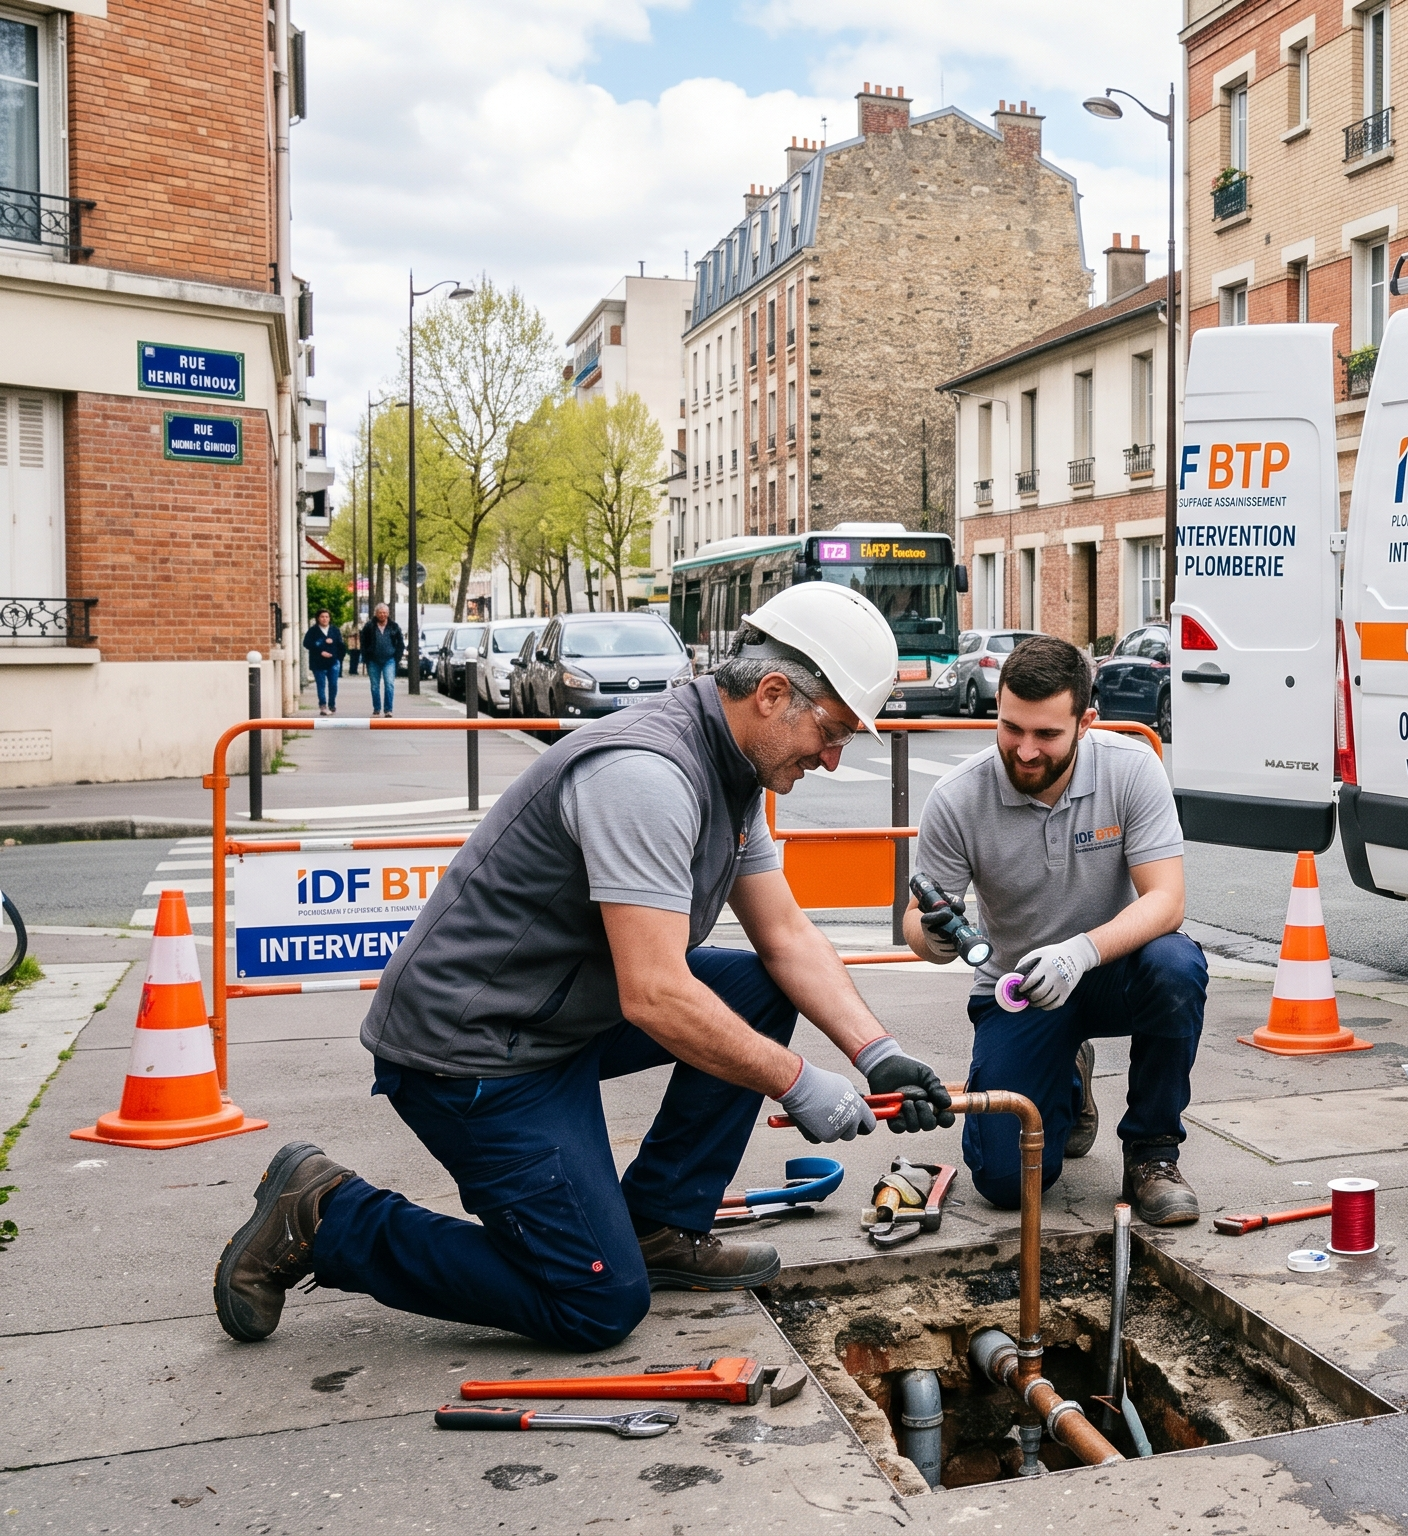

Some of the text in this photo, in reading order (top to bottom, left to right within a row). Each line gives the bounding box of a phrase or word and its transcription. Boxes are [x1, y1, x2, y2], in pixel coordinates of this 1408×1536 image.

[179, 355, 206, 370] RUE
[148, 369, 236, 391] HENRI GINOUX
[193, 423, 214, 436] RUE
[1208, 442, 1290, 490] BTP
[1214, 496, 1287, 507] ASSAINISSEMENT
[1185, 555, 1284, 577] PLOMBERIE
[297, 868, 371, 905] IDF
[260, 930, 410, 963] INTERVEN
